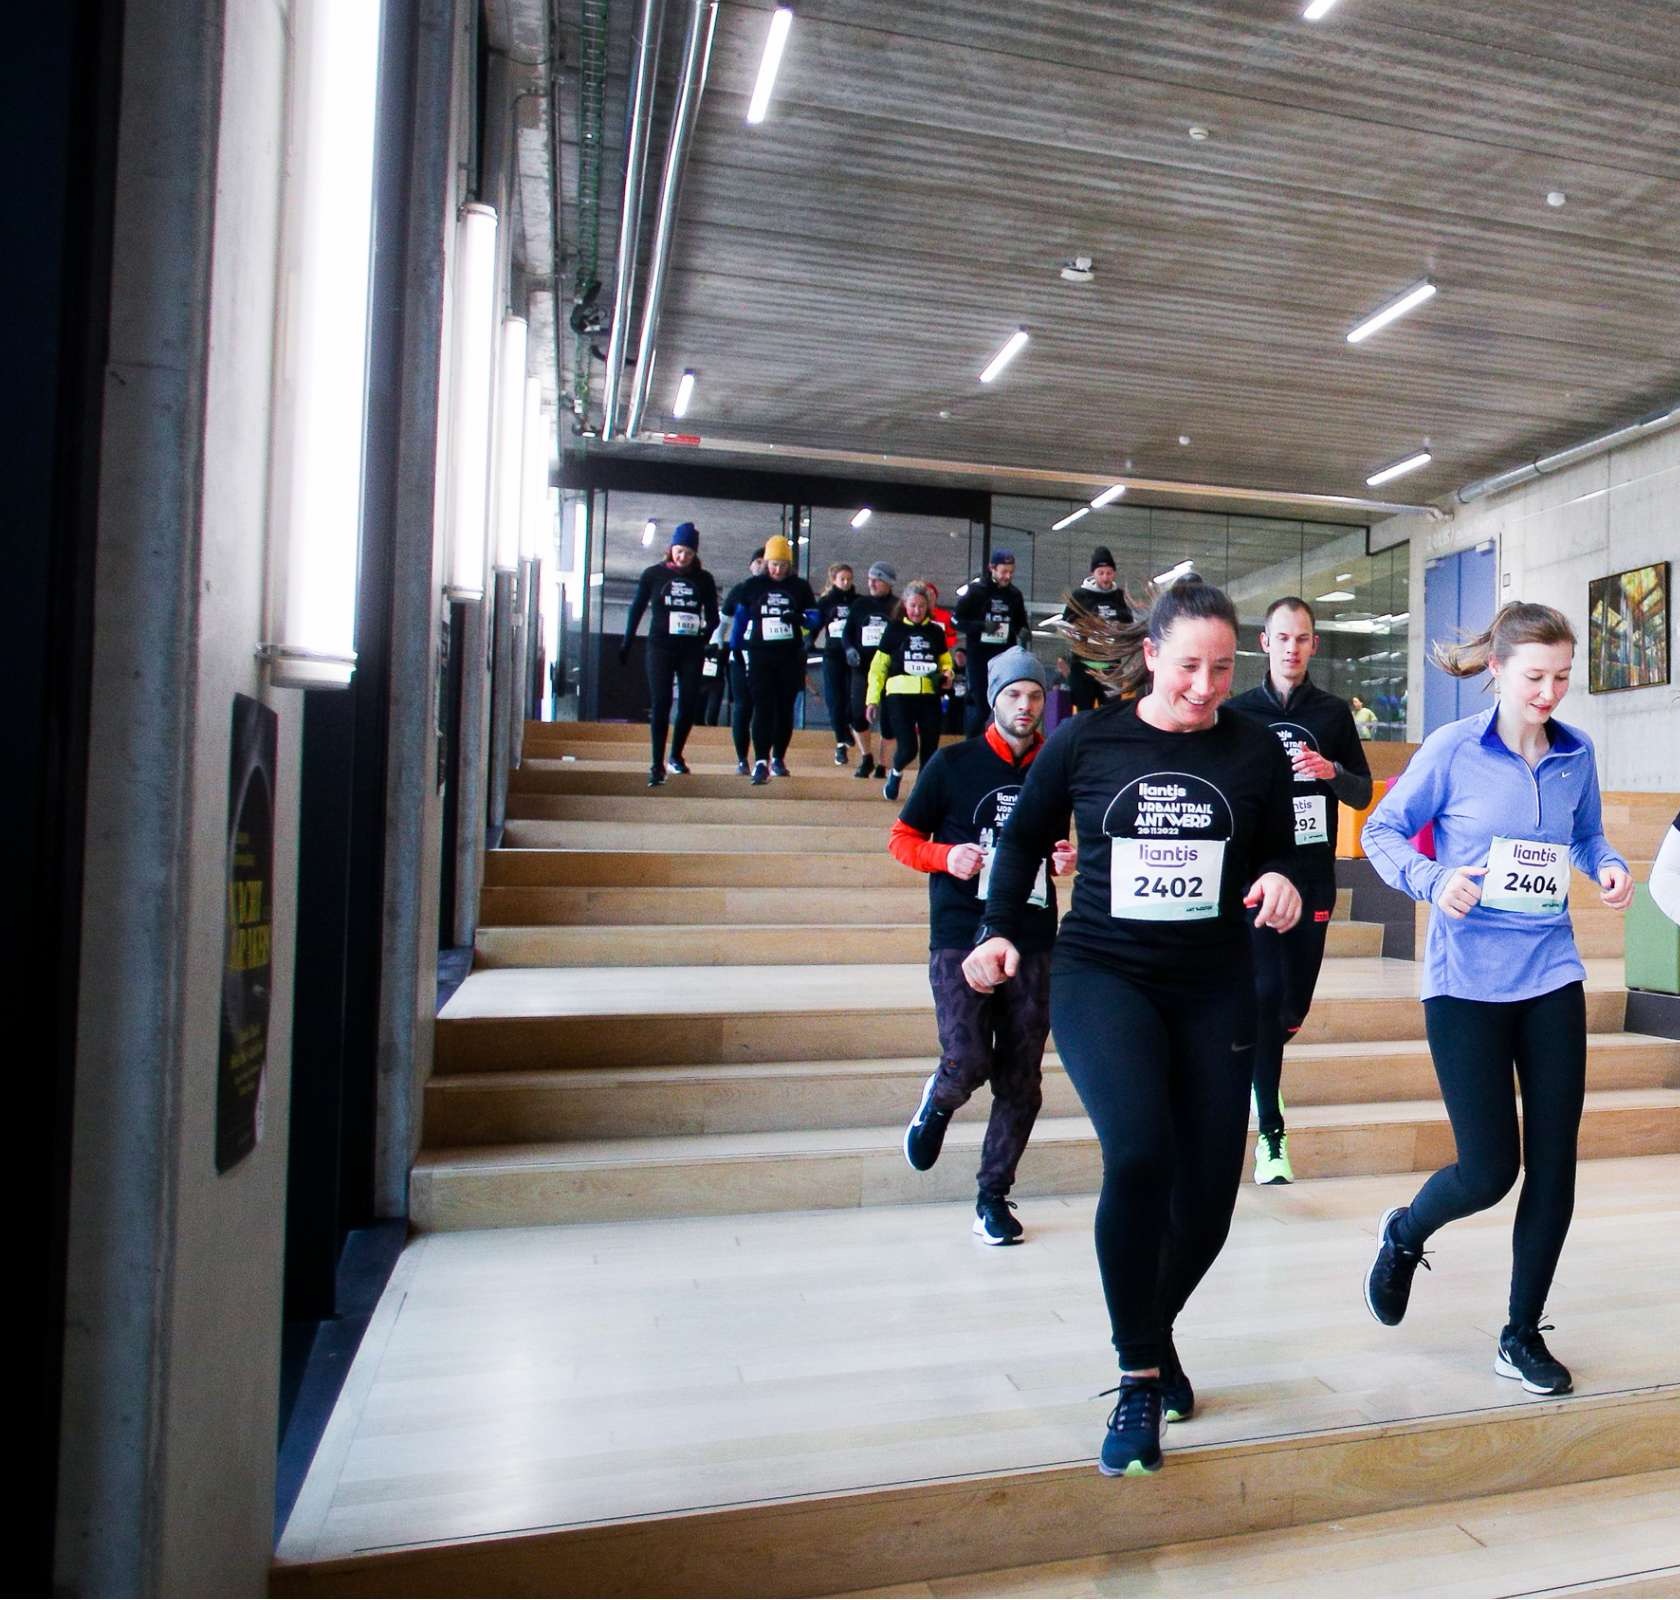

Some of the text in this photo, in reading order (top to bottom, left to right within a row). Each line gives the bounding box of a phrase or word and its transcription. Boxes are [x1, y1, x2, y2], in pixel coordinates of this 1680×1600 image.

[1139, 783, 1186, 799] liantis
[1138, 802, 1214, 815] URBAN TRAIL
[1134, 813, 1212, 829] ANTWERP
[1139, 844, 1198, 864] liantis
[1513, 844, 1557, 866] liantis
[1134, 876, 1203, 898] 2402
[1504, 872, 1557, 895] 2404
